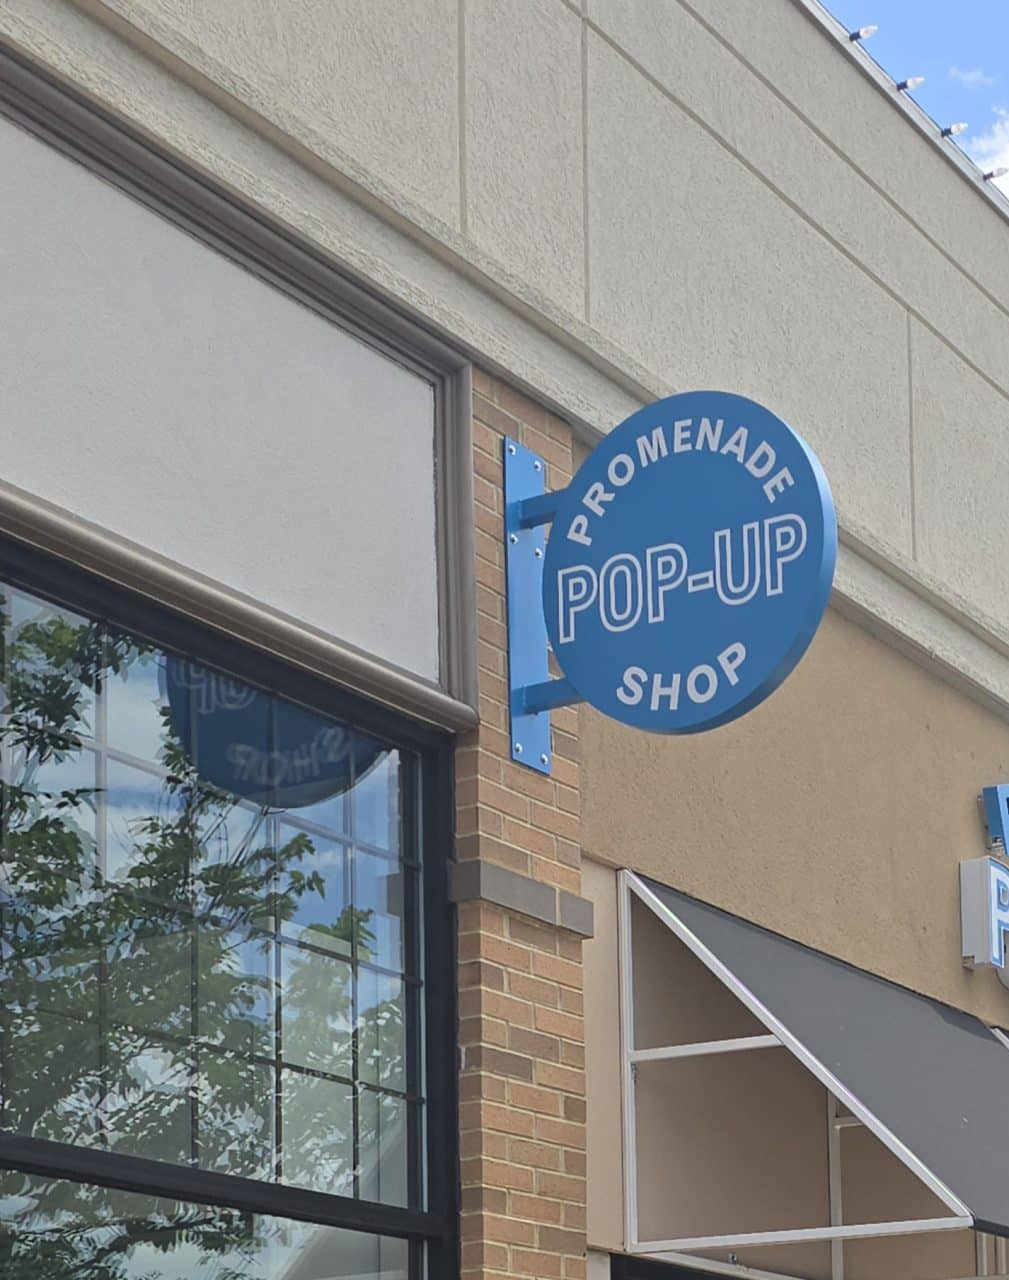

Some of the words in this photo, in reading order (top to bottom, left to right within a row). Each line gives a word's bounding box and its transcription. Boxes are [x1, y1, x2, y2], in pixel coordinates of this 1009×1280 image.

[567, 417, 795, 547] PROMENADE
[557, 513, 808, 644] POP-UP
[616, 641, 748, 711] SHOP
